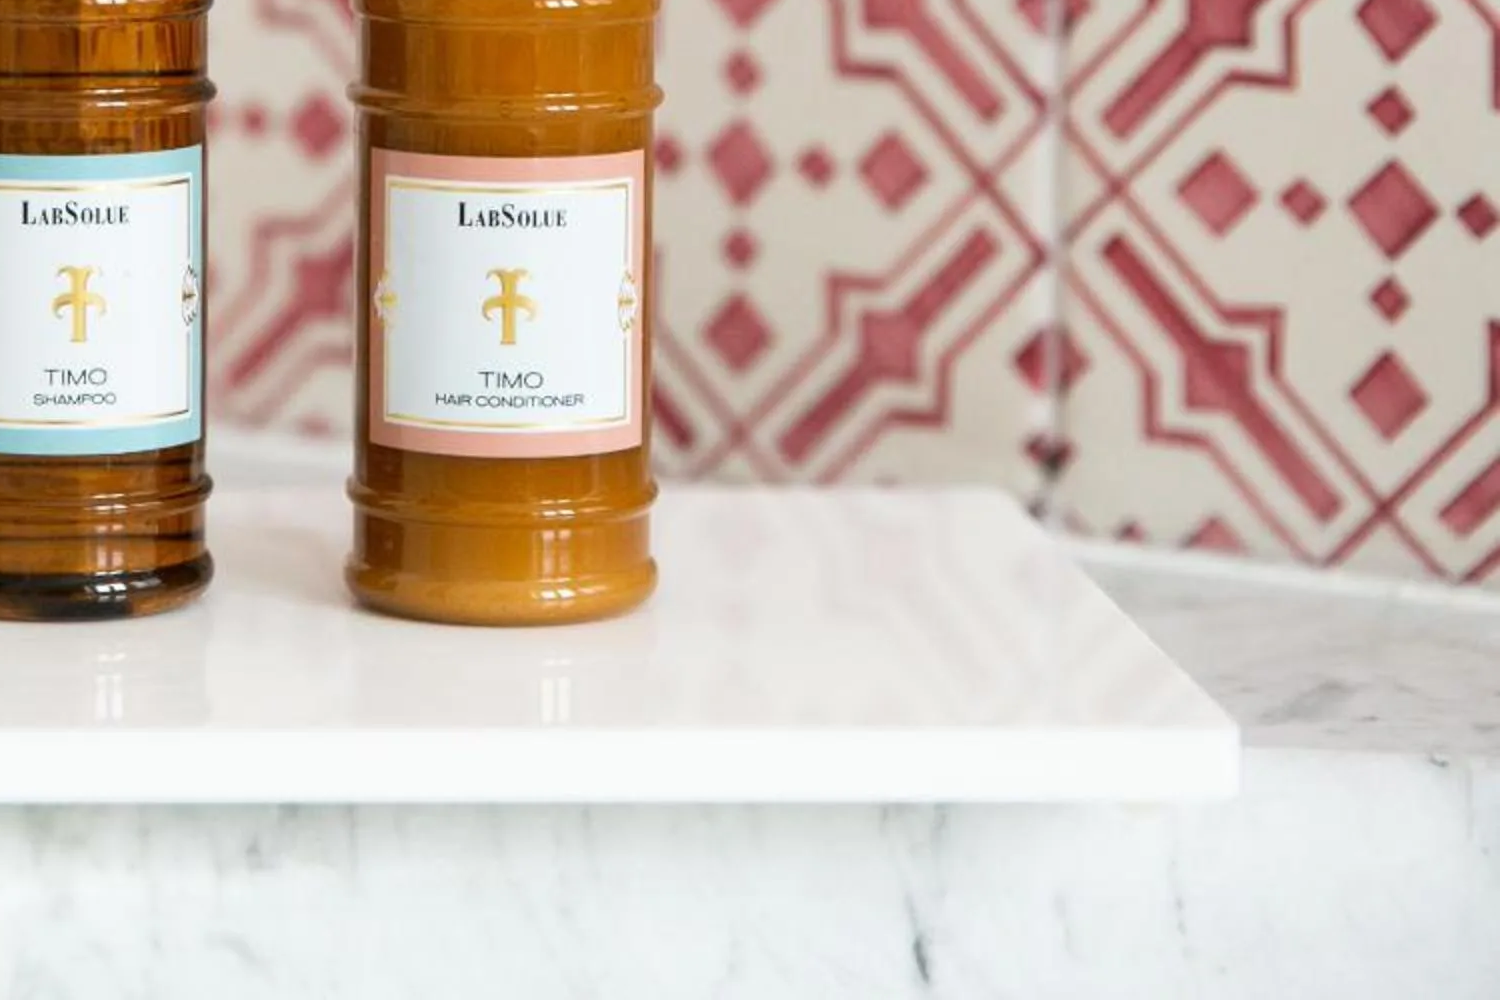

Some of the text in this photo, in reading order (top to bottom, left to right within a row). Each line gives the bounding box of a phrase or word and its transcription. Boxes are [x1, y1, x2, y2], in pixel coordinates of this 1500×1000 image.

[44, 367, 107, 386] TIMO
[478, 371, 544, 389] TIMO
[33, 392, 117, 406] SHAMPOO
[435, 393, 584, 409] HAIR CONDITIONER
